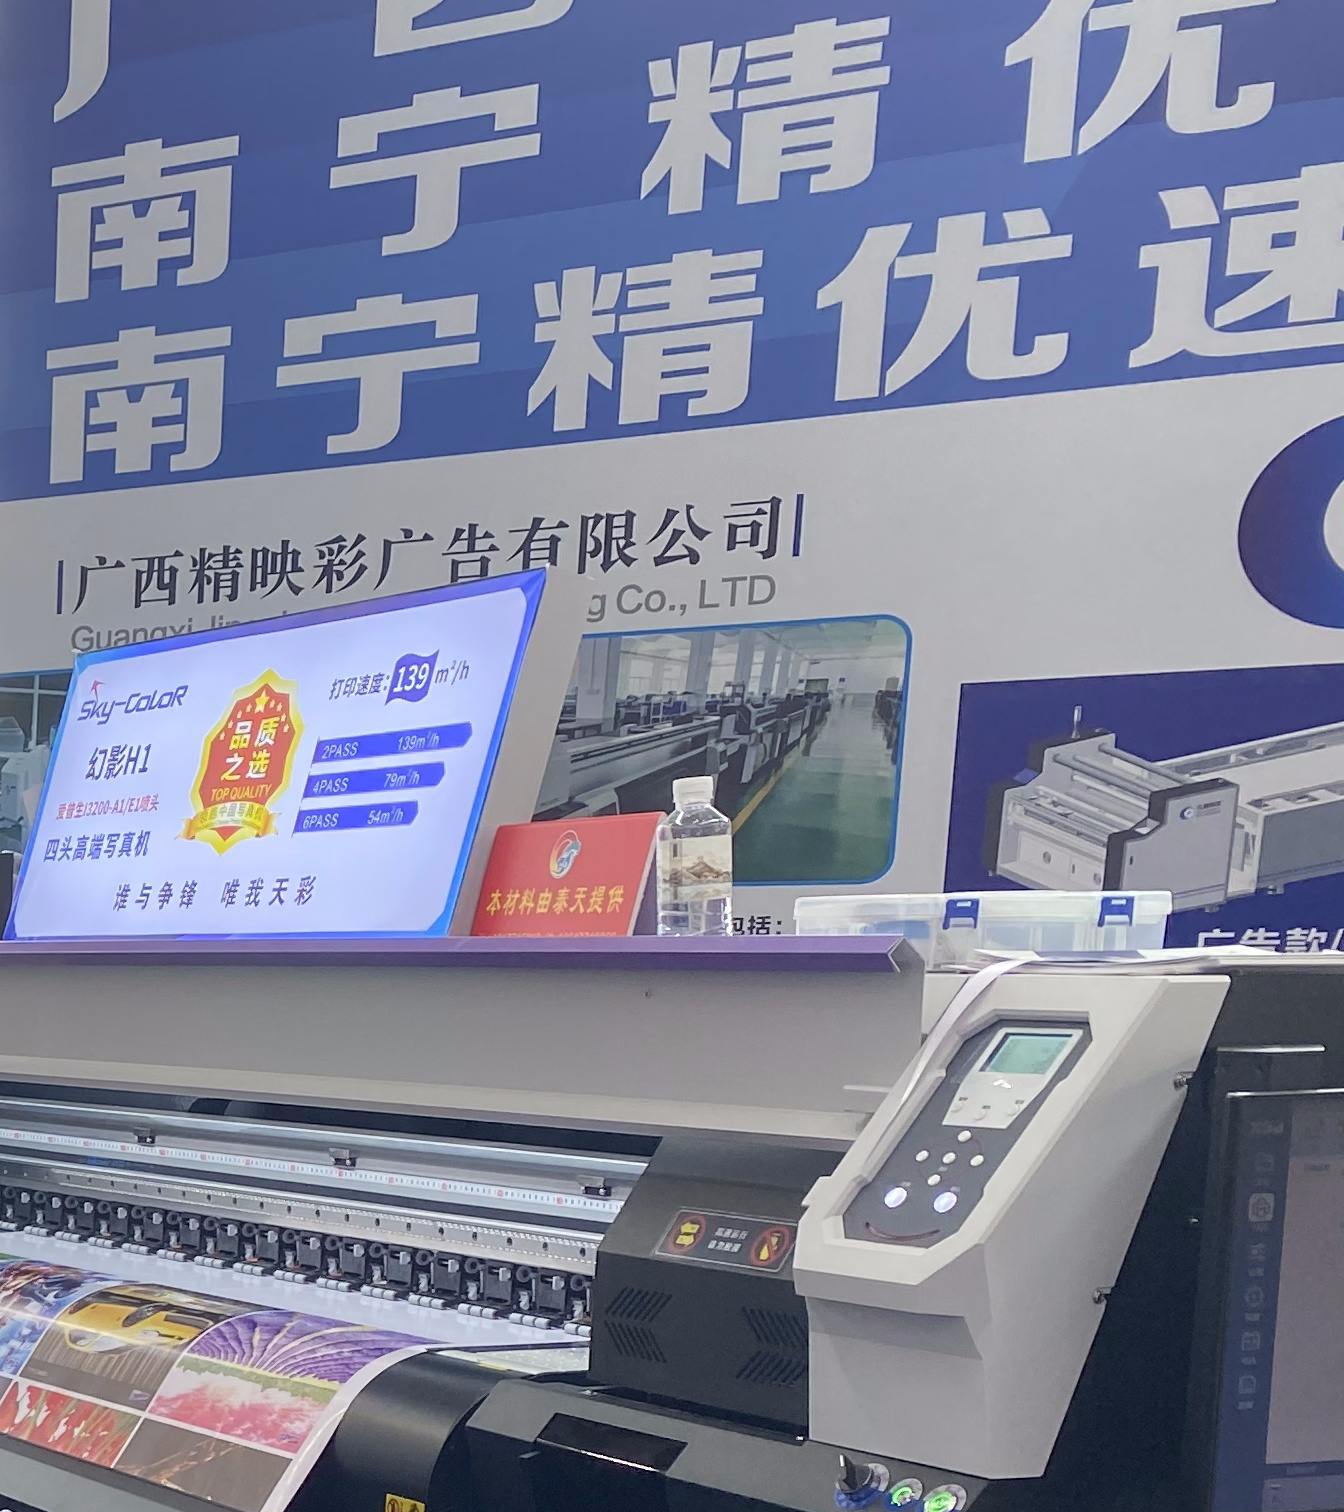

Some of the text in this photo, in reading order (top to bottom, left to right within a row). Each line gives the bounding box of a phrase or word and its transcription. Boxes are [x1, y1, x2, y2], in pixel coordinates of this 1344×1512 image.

[70, 495, 784, 616] 广西精映彩广告有限公司
[615, 583, 689, 617] Co.,
[698, 574, 777, 609] LTD
[393, 662, 431, 694] 139
[229, 716, 281, 751] 品质
[85, 743, 152, 782] 幻影H1
[220, 748, 271, 782] 之选
[321, 741, 359, 760] 2PASS
[211, 783, 273, 801] TOP QUALITY
[312, 777, 349, 795] 4PASS
[302, 813, 340, 830] 6PASS
[113, 879, 198, 912] 谁与争锋
